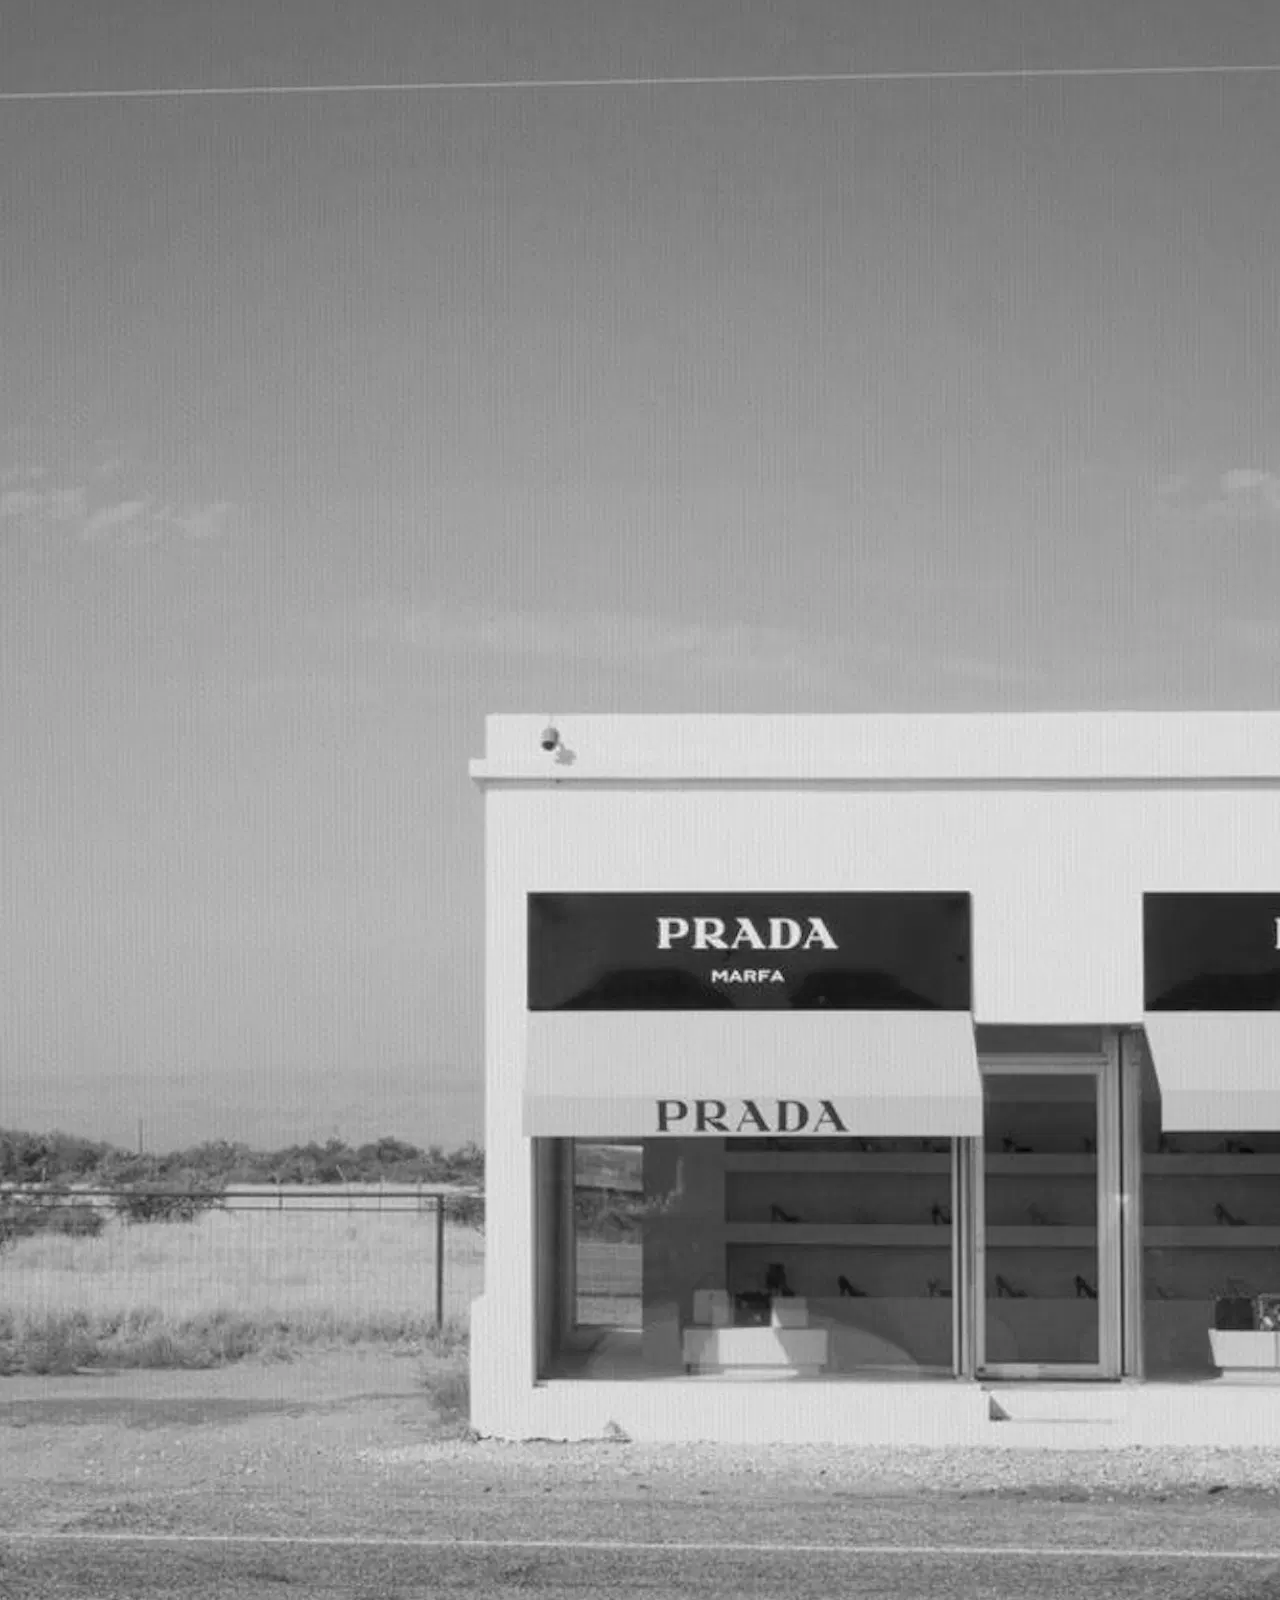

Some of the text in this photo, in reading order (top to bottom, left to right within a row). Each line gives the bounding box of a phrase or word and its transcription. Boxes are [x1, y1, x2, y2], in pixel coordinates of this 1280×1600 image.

[656, 916, 839, 950] PRADA
[711, 968, 785, 984] MARFA
[656, 1099, 849, 1133] PRADA
